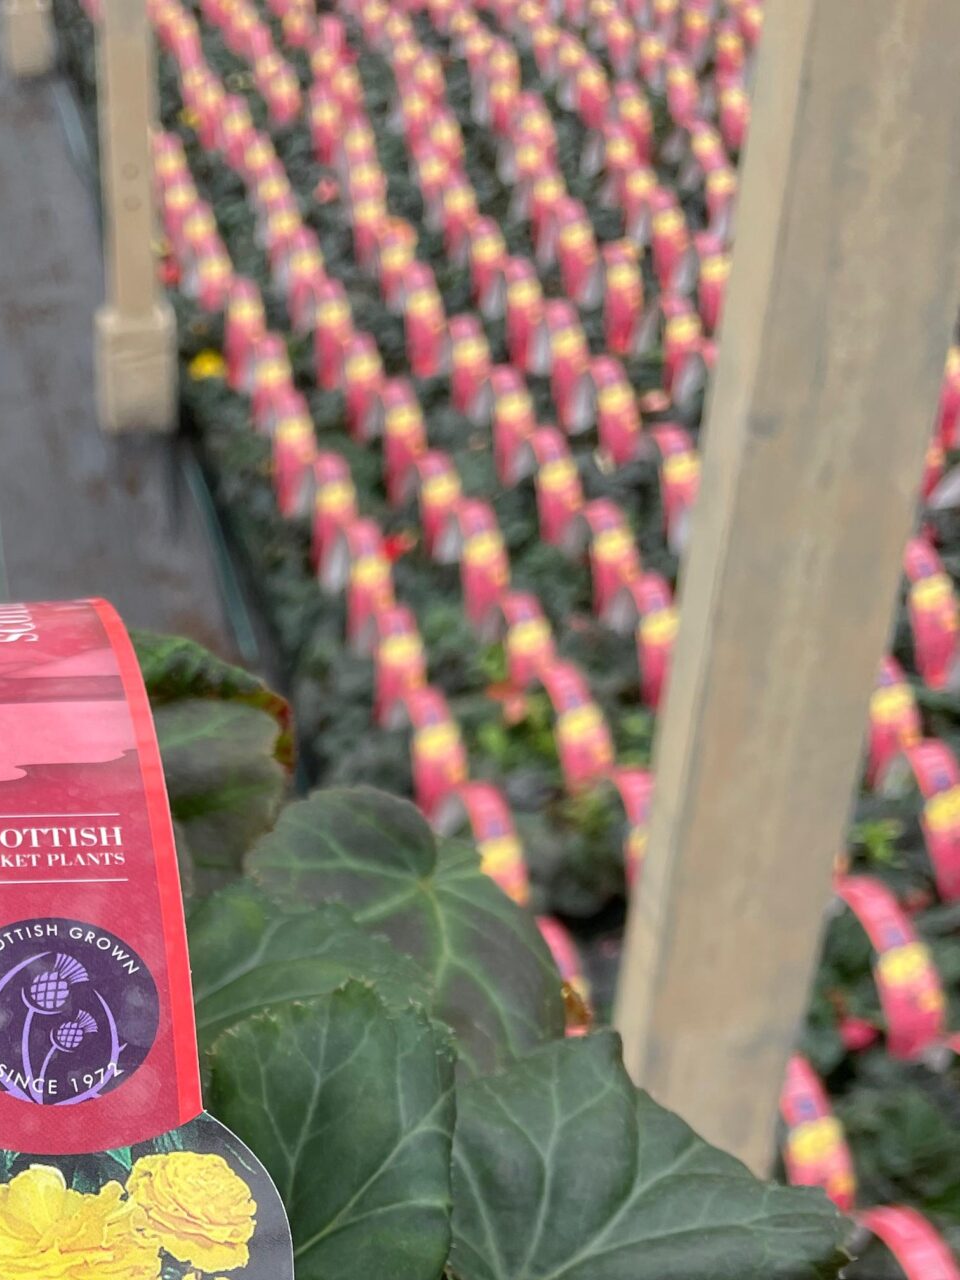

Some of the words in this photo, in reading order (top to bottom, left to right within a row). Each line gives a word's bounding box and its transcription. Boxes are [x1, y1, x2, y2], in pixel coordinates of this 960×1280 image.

[47, 852, 126, 867] PLANTS
[69, 927, 140, 976] GROWN
[70, 1062, 125, 1093] 1972
